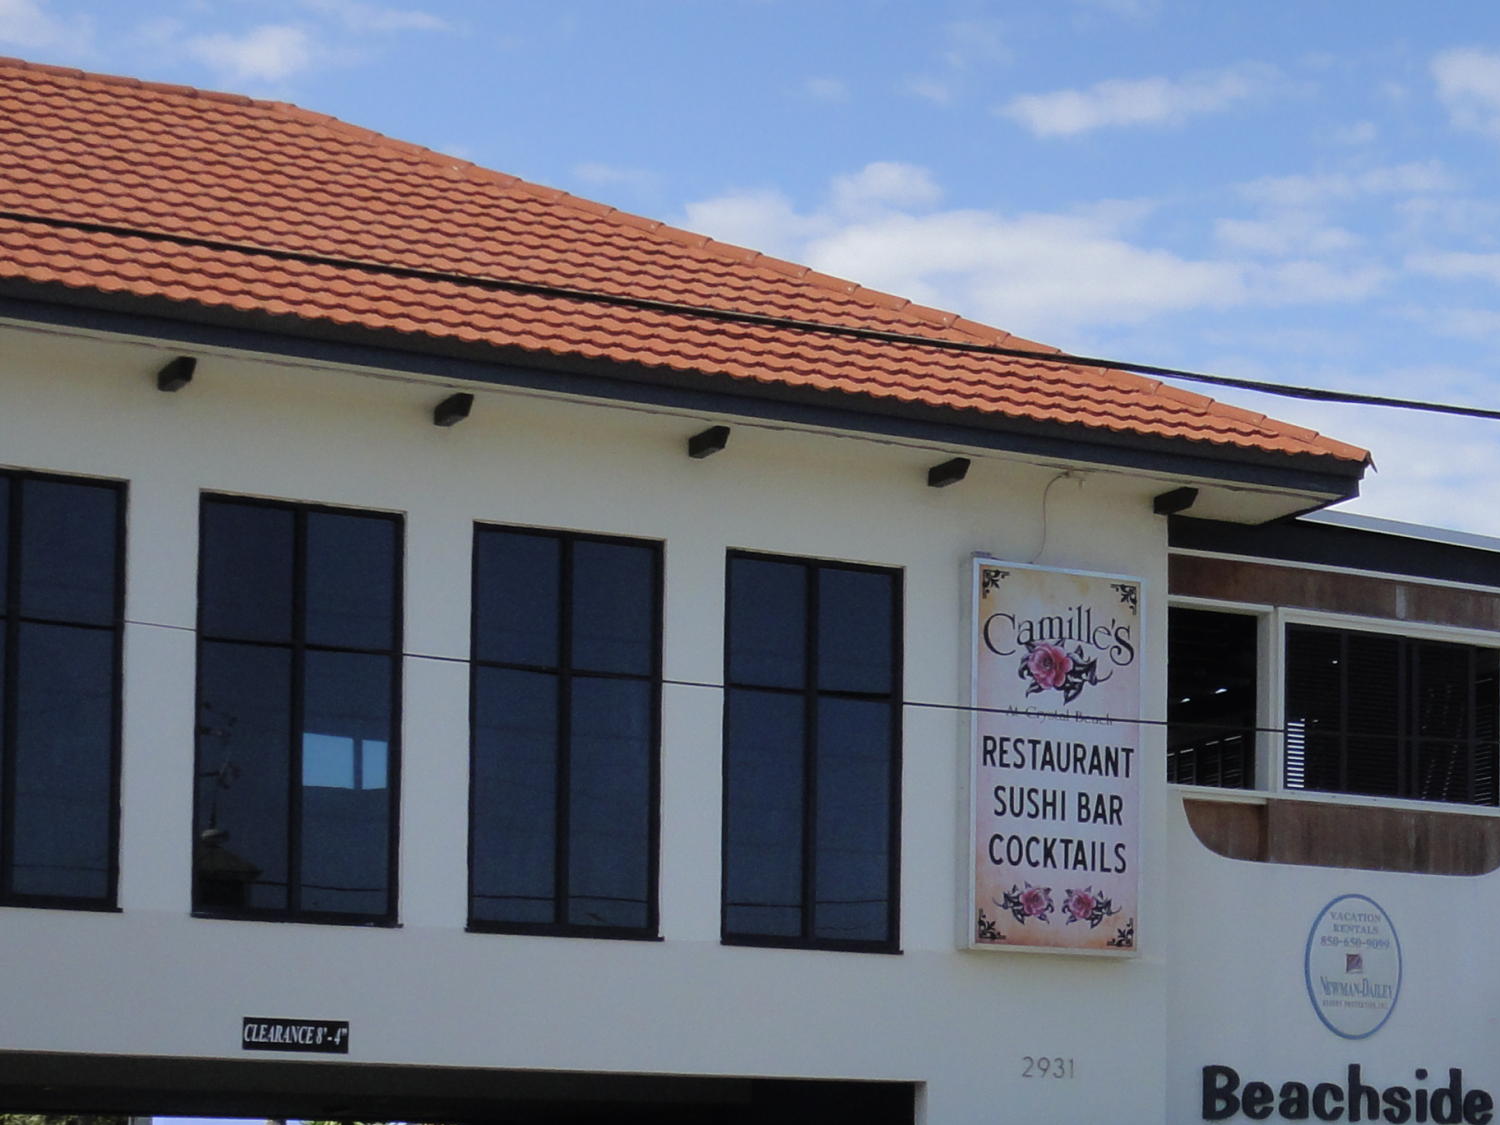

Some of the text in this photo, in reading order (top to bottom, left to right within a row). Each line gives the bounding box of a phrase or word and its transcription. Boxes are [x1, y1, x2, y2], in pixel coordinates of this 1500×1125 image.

[982, 735, 1135, 779] RESTAURANT
[993, 785, 1123, 826] SUSHI BAR
[988, 834, 1128, 874] COCKTAILS
[1330, 911, 1382, 922] VACATION
[1333, 924, 1378, 935] RENTALS
[244, 1024, 315, 1044] CLEARANCE
[1022, 1056, 1074, 1079] 2931
